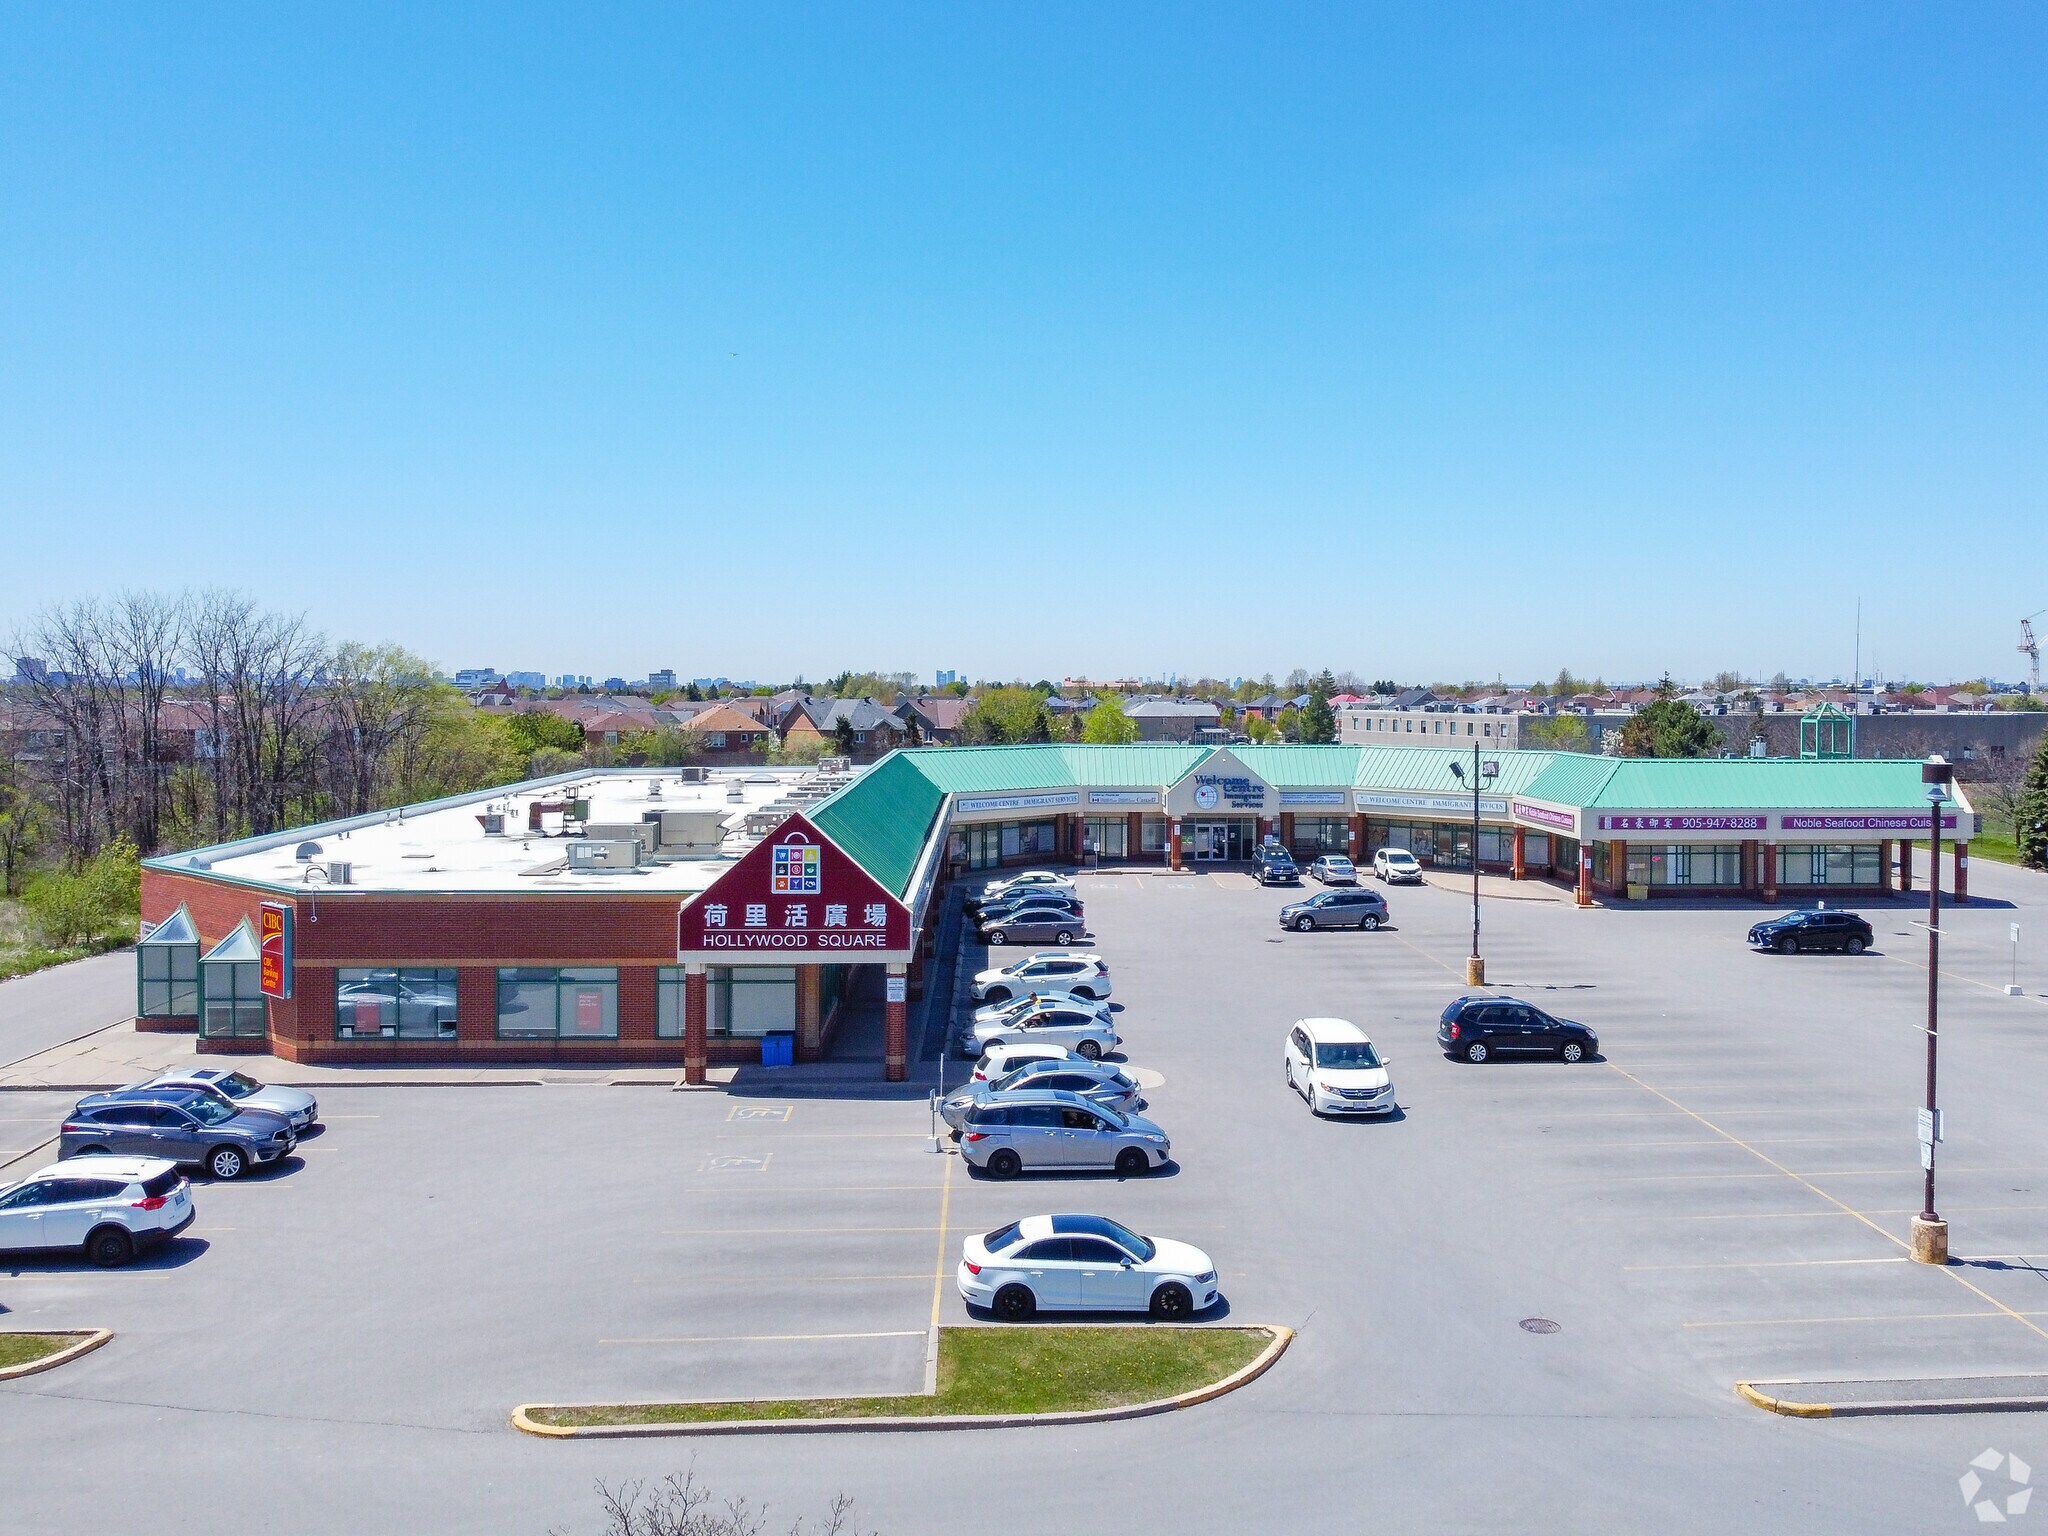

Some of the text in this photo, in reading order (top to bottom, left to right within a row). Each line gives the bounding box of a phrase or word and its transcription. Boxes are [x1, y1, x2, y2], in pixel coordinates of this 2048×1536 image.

[1194, 774, 1250, 785] Welcome
[1223, 783, 1264, 793] Centre
[970, 801, 998, 809] WELCOME
[1024, 797, 1054, 806] IMMIGRANT
[1055, 795, 1078, 804] SERVICES
[1224, 793, 1265, 802] Immigrant
[1369, 796, 1504, 810] WELCOME CENTRE IMMIGRANT RVICES
[1231, 801, 1264, 809] Services
[1682, 818, 1758, 829] 905-947-8288
[1793, 817, 1946, 828] Noble Seafood Chinese Cuise
[263, 912, 282, 930] CIBC
[703, 903, 888, 927] 荷里活廣場
[703, 934, 887, 948] HOLLYWOOD SQUARE
[263, 967, 279, 980] Banking
[262, 976, 276, 989] Centre
